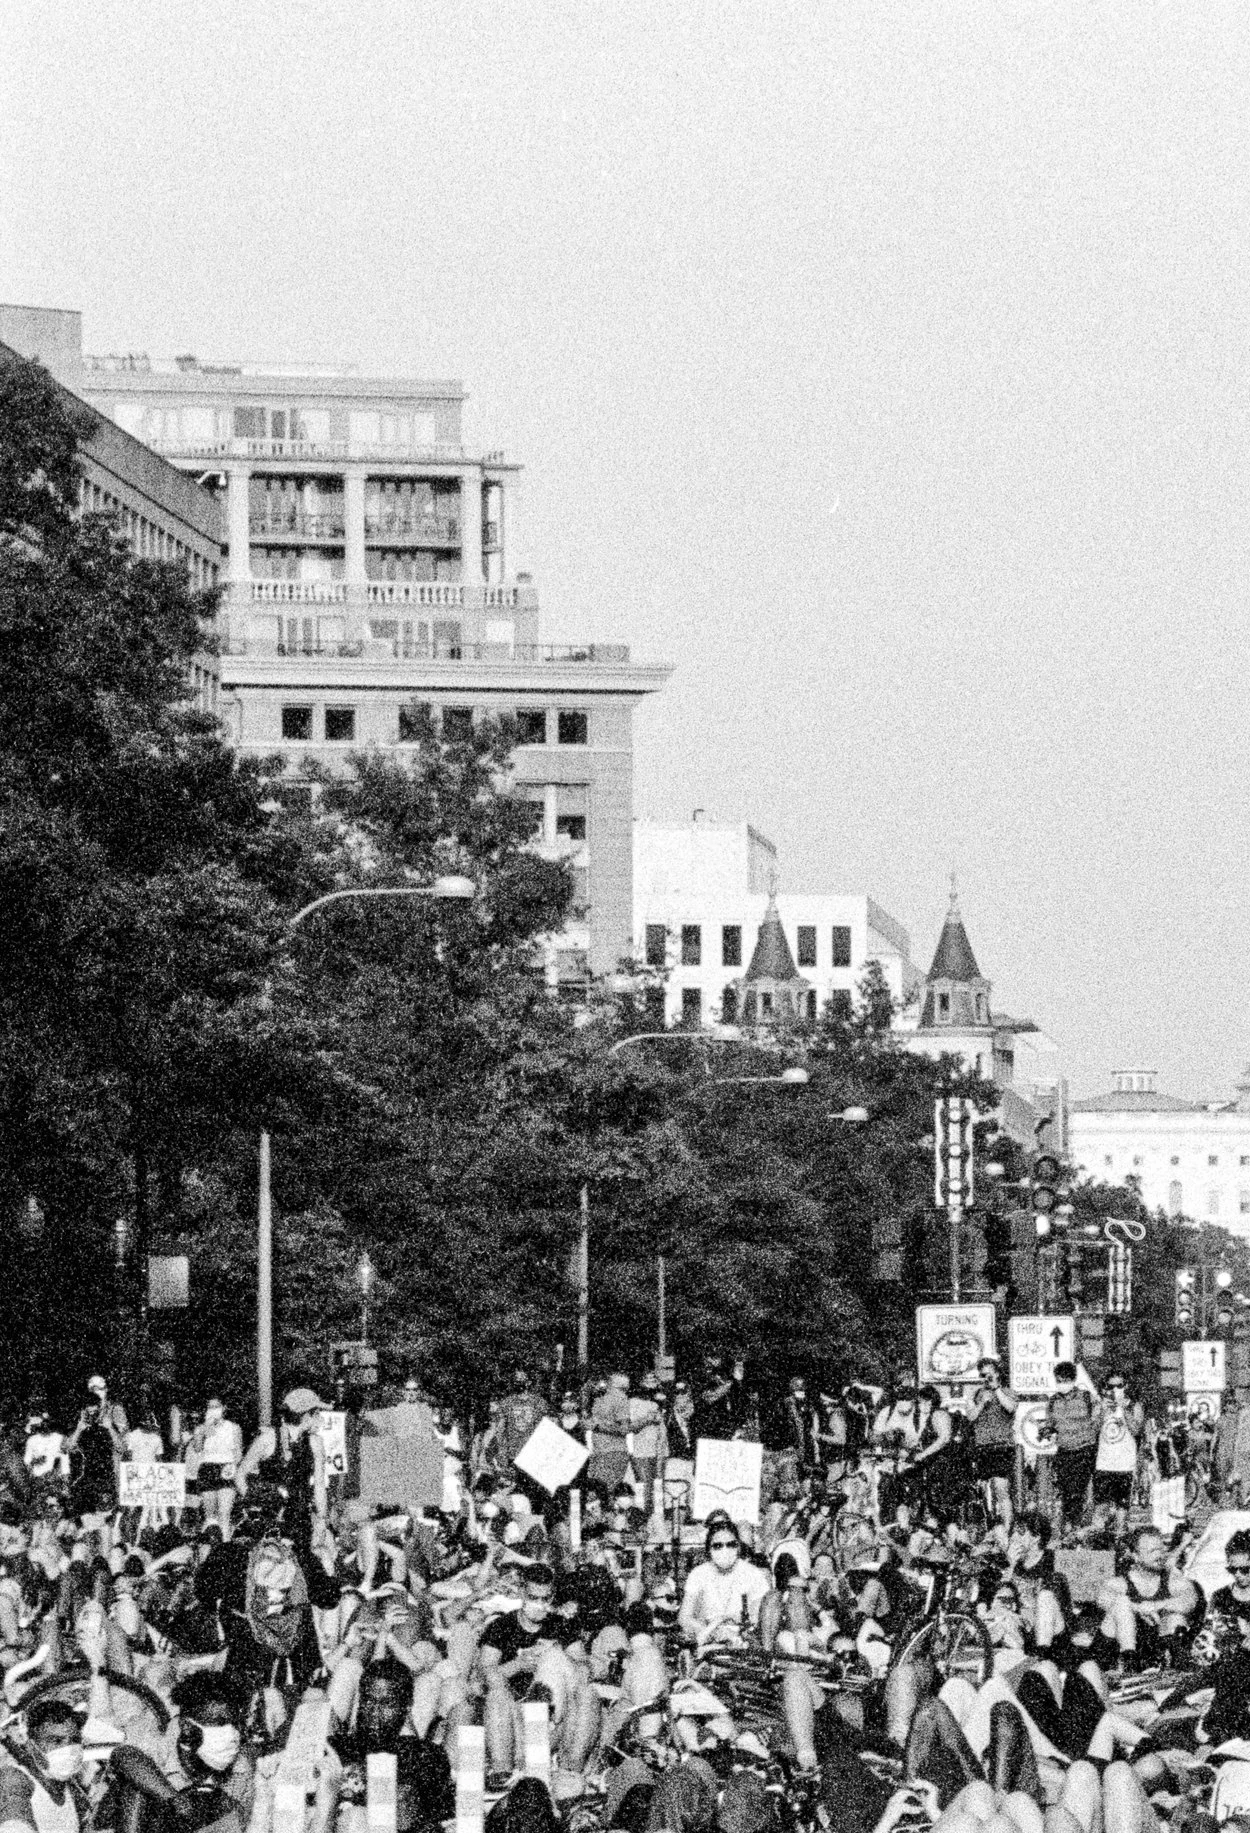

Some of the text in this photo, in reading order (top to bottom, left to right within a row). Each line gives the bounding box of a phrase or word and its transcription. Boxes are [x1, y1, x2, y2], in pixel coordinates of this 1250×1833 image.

[935, 1313, 979, 1326] TURNING
[1016, 1322, 1043, 1335] THRU
[1015, 1361, 1042, 1374] OBEY
[1015, 1375, 1050, 1388] SIGNAL
